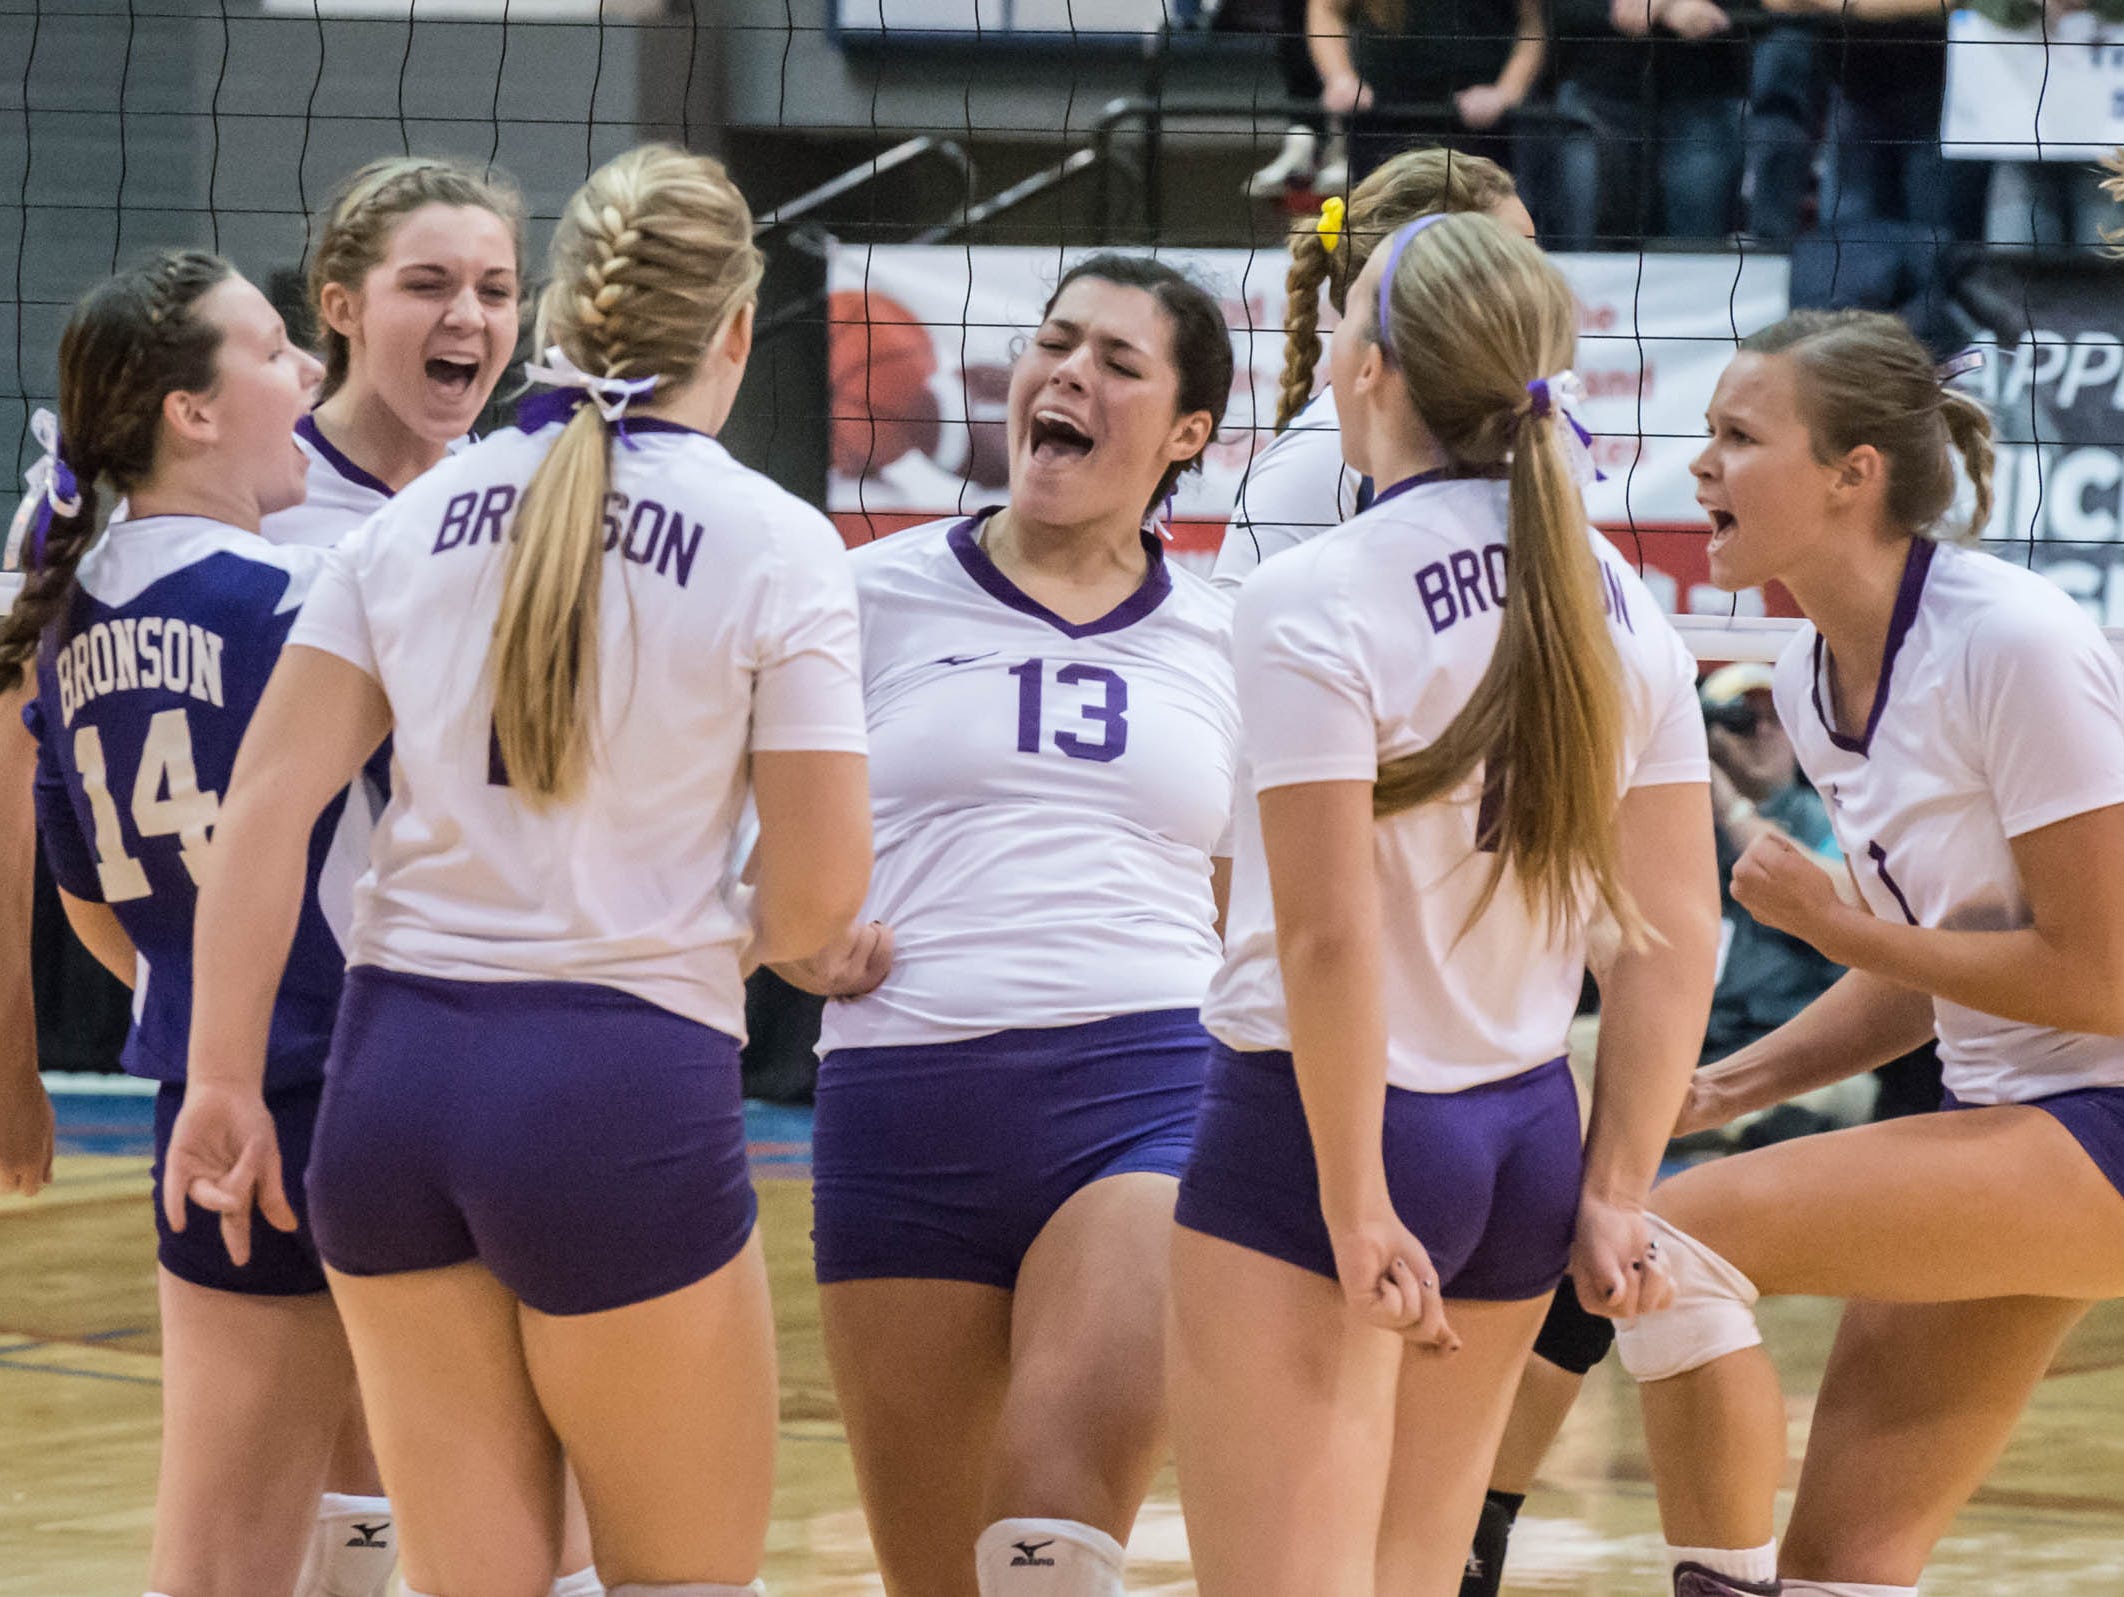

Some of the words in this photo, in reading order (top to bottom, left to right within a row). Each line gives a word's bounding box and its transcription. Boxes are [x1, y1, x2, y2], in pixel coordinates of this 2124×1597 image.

[431, 484, 704, 588] BRSON
[56, 617, 224, 728] BRONSON
[1008, 658, 1128, 762] 13
[74, 708, 221, 902] 14
